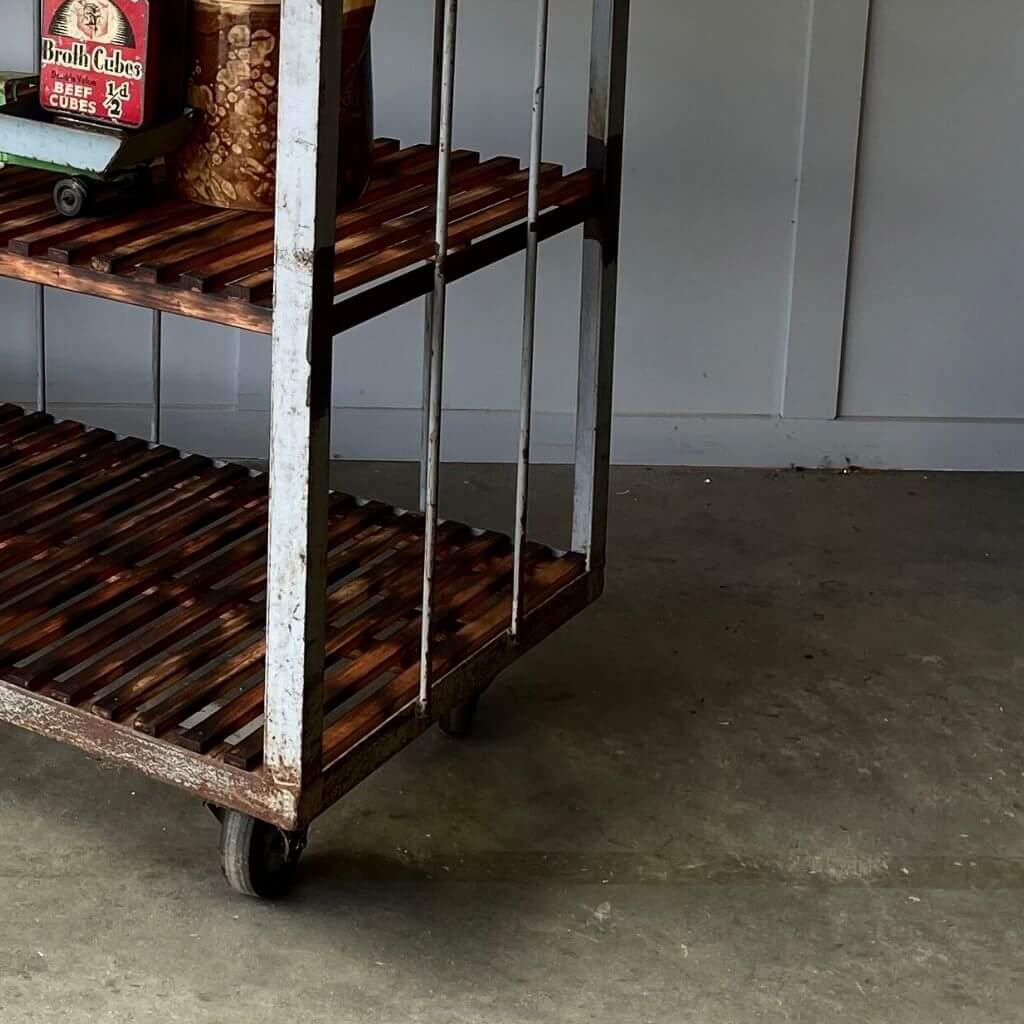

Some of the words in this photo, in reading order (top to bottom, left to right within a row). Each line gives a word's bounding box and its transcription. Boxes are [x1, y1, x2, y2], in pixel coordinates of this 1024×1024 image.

[93, 46, 142, 80] Cubes
[54, 81, 93, 98] BEEF
[49, 94, 97, 114] CUBES
